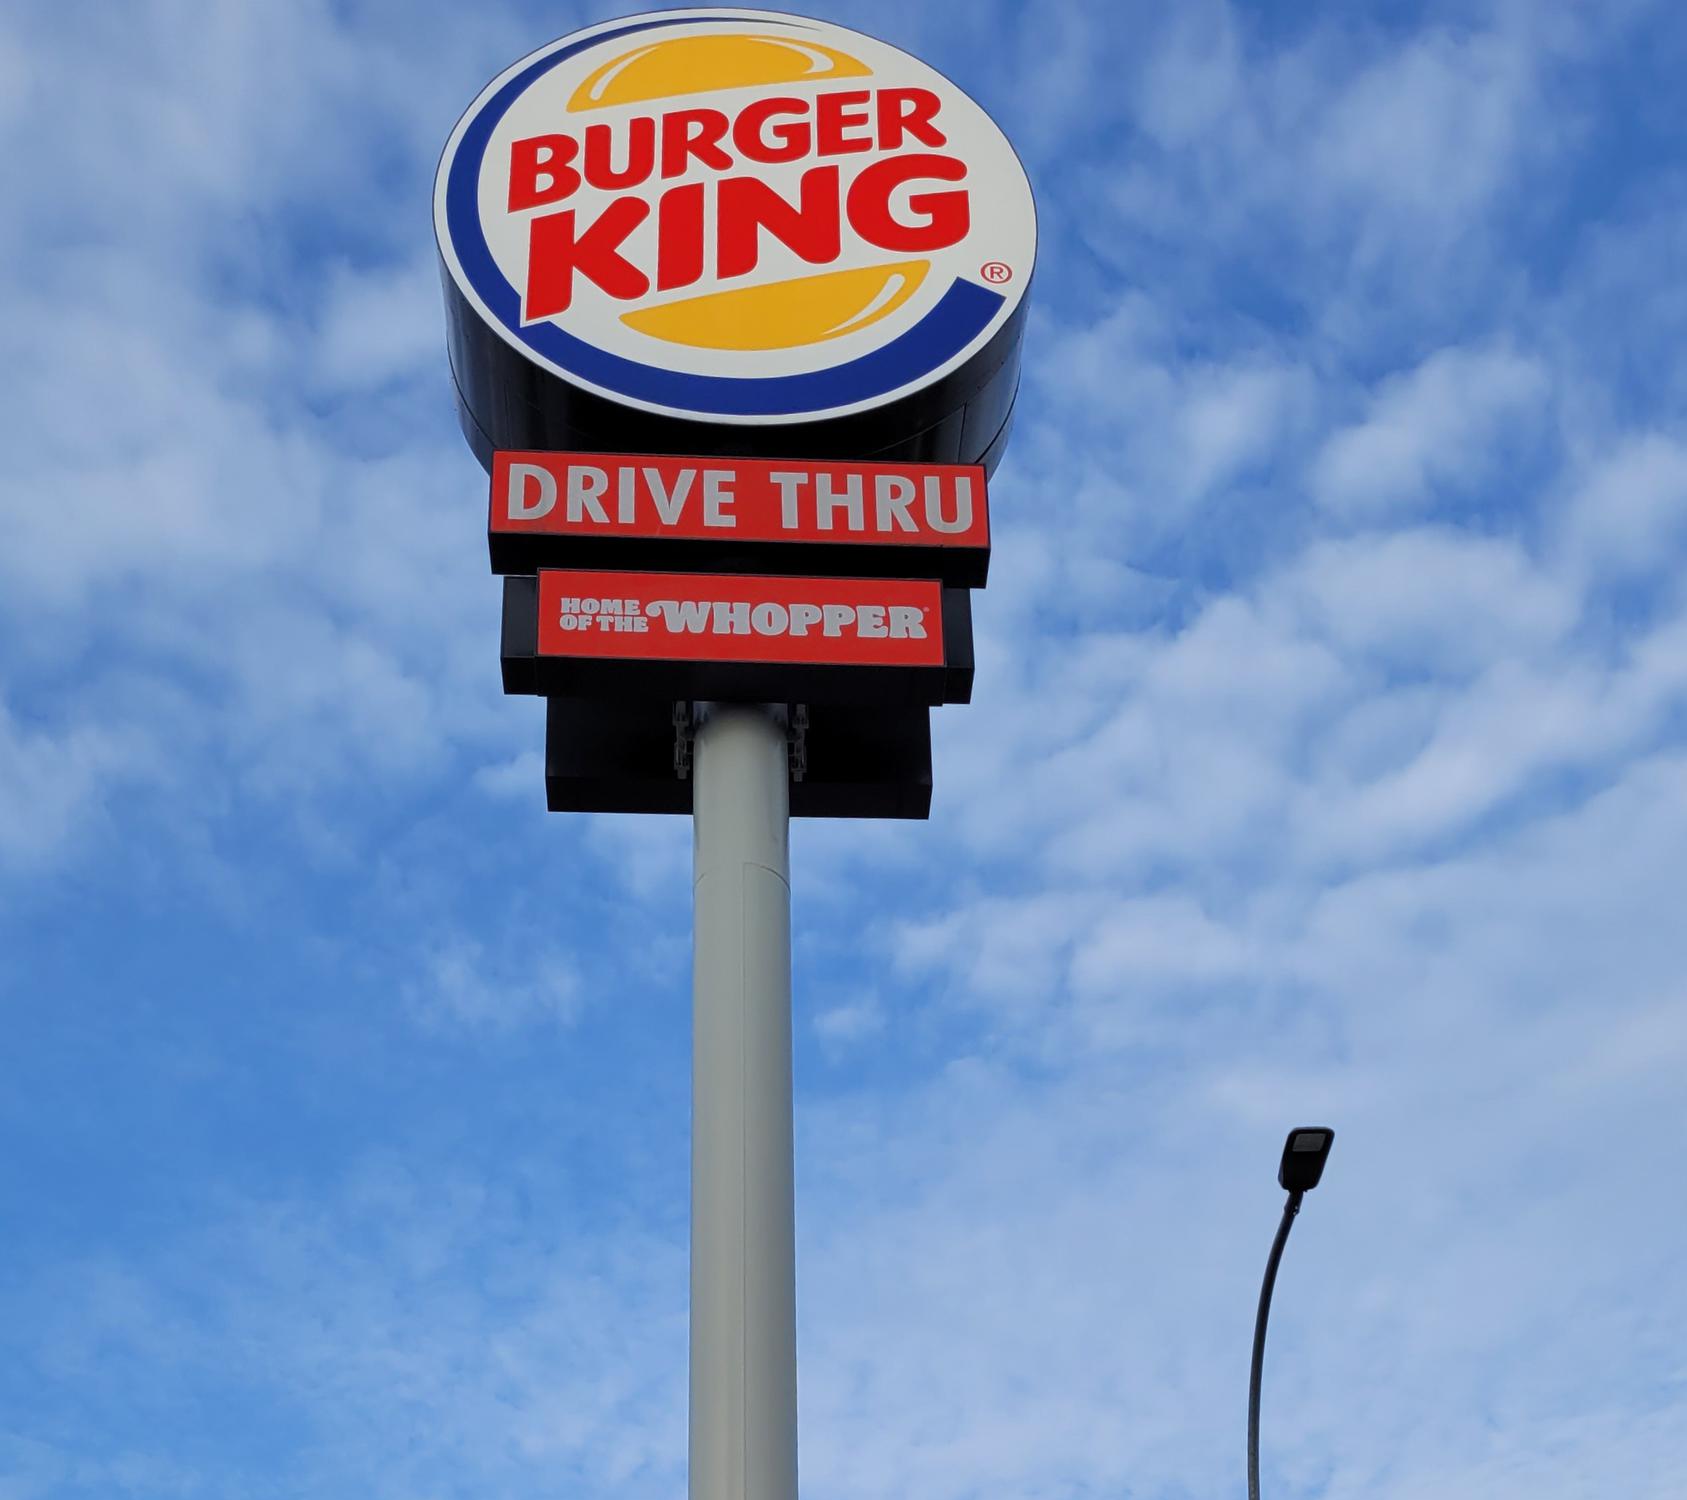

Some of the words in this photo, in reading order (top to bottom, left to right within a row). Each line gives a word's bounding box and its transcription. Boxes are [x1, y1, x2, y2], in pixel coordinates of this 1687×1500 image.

[507, 86, 948, 214] BURGER
[525, 153, 971, 322] KING
[507, 463, 737, 528] DRIVE
[770, 471, 974, 535] THRU
[559, 614, 593, 631] OF
[596, 615, 649, 633] THE
[560, 597, 641, 615] HOME
[645, 600, 928, 639] WHOPPER
